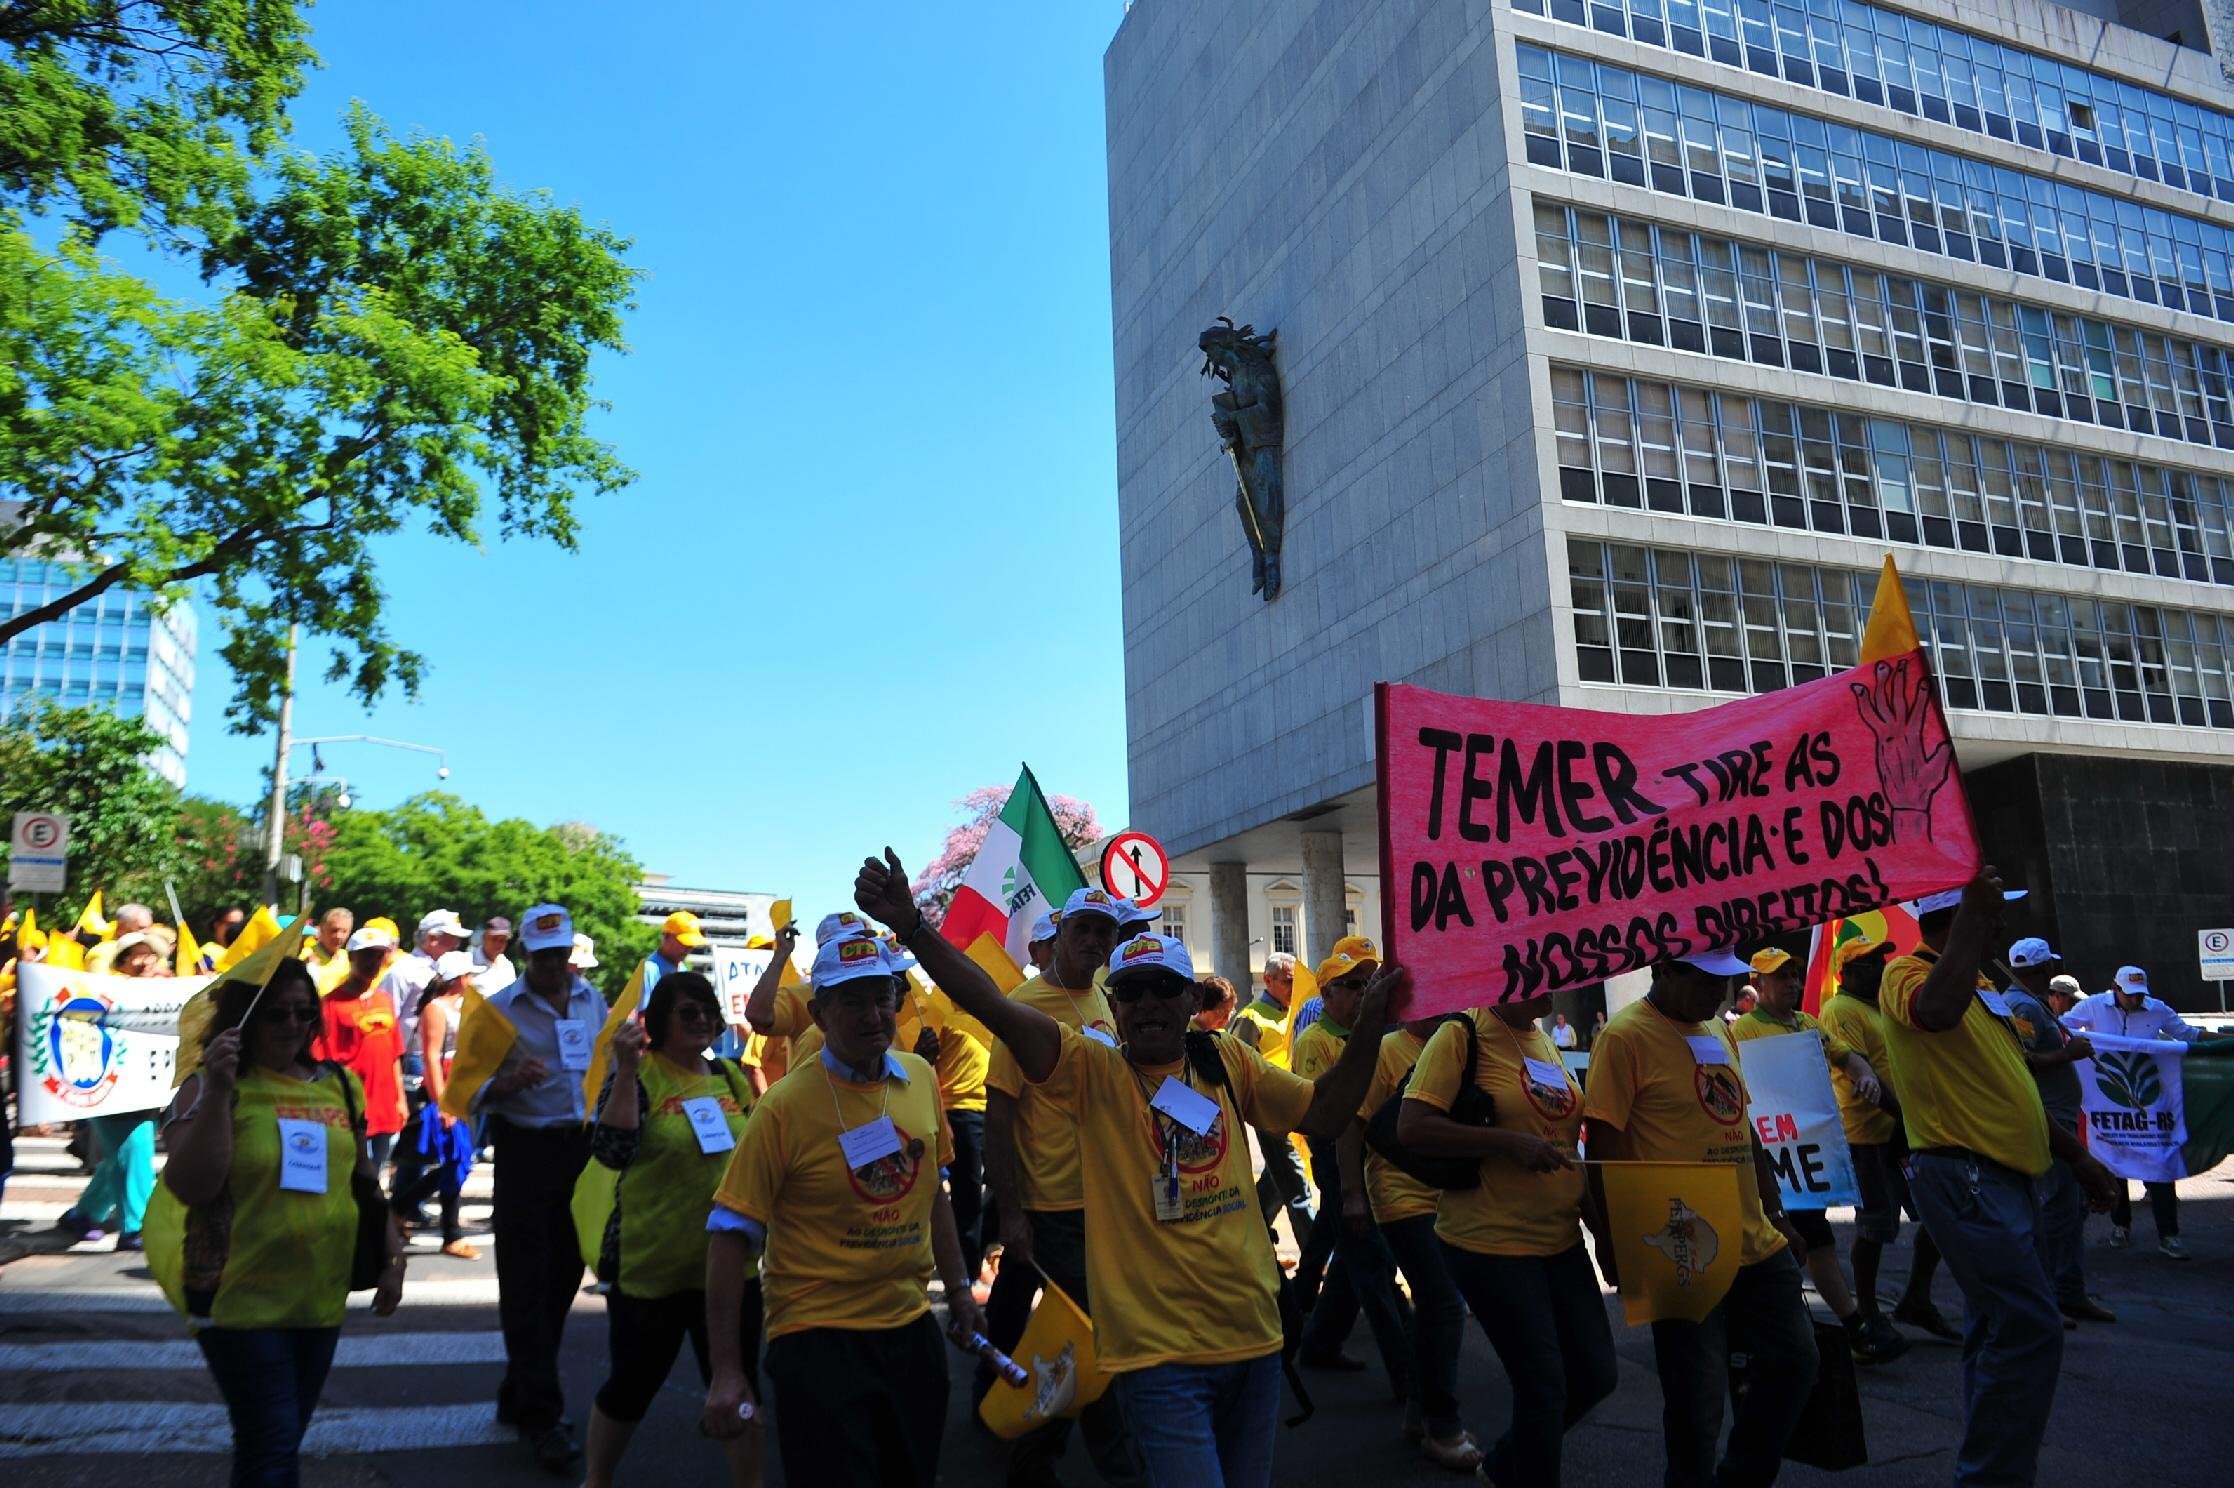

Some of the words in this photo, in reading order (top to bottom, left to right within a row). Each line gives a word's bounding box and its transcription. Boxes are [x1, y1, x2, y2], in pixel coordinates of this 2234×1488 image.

[1419, 727, 1667, 843] TEMER
[1662, 740, 1773, 806] TIRE
[1785, 731, 1840, 792] AS
[33, 824, 48, 842] E
[1411, 861, 1474, 932] DA
[1784, 806, 1809, 865] E
[1820, 791, 1890, 859] DOS
[2213, 936, 2221, 947] E
[1499, 912, 1691, 1003] NOSSOS
[2091, 1111, 2175, 1131] FETAG-RS
[1193, 1174, 1220, 1192] NÃO
[873, 1207, 900, 1222] NÃO
